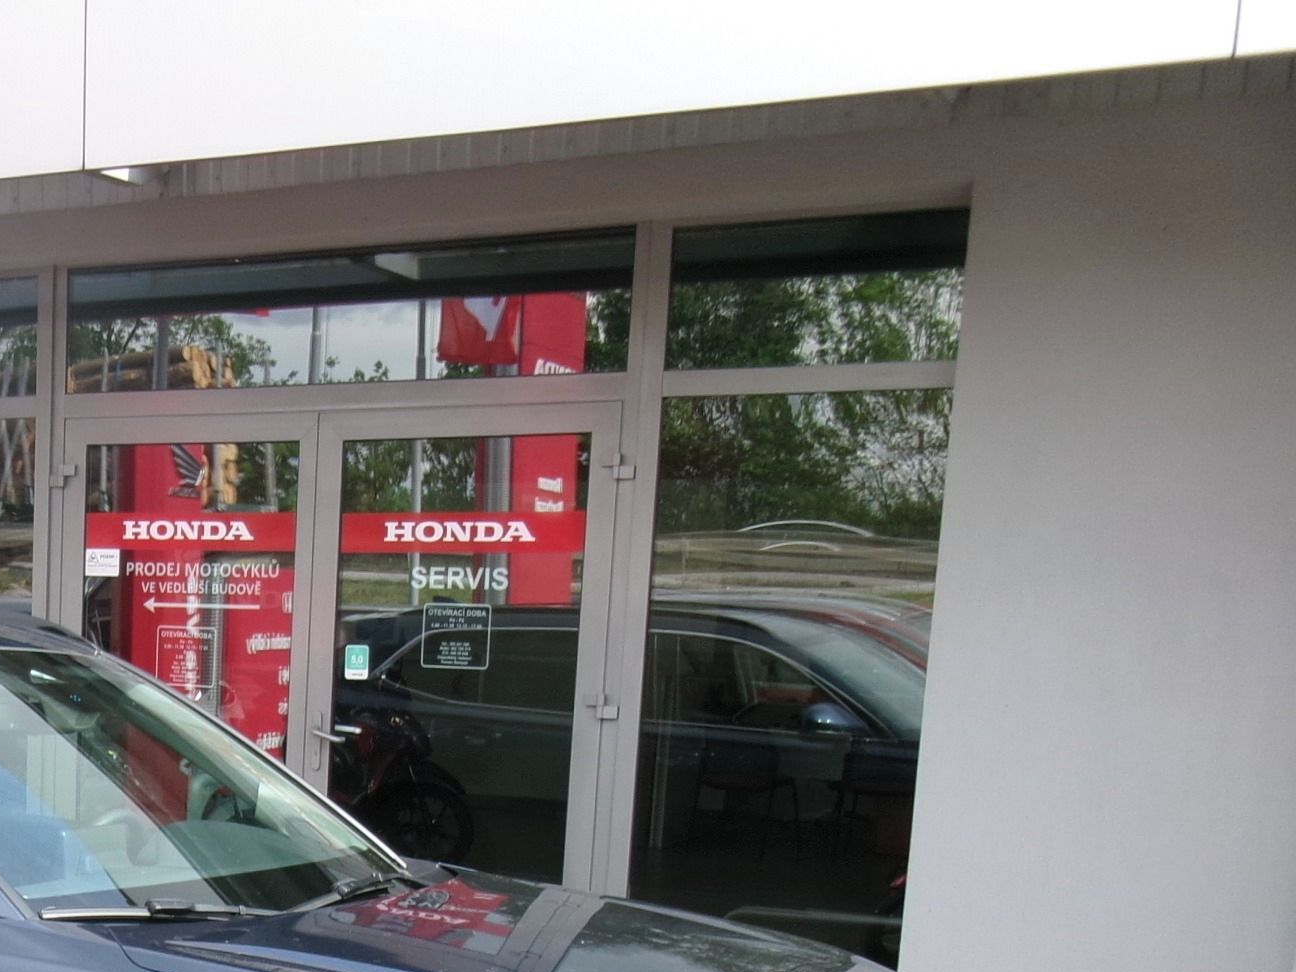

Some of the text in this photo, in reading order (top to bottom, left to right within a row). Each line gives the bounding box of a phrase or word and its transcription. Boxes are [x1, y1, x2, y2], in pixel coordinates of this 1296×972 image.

[122, 520, 254, 541] HONDA
[383, 520, 536, 542] HONDA
[125, 561, 181, 577] PRODEJ
[185, 558, 280, 578] MOTOCYKLŮ
[410, 566, 510, 591] SERVIS
[141, 580, 262, 596] VE VEDLEJŠÍ BUDOVĚ
